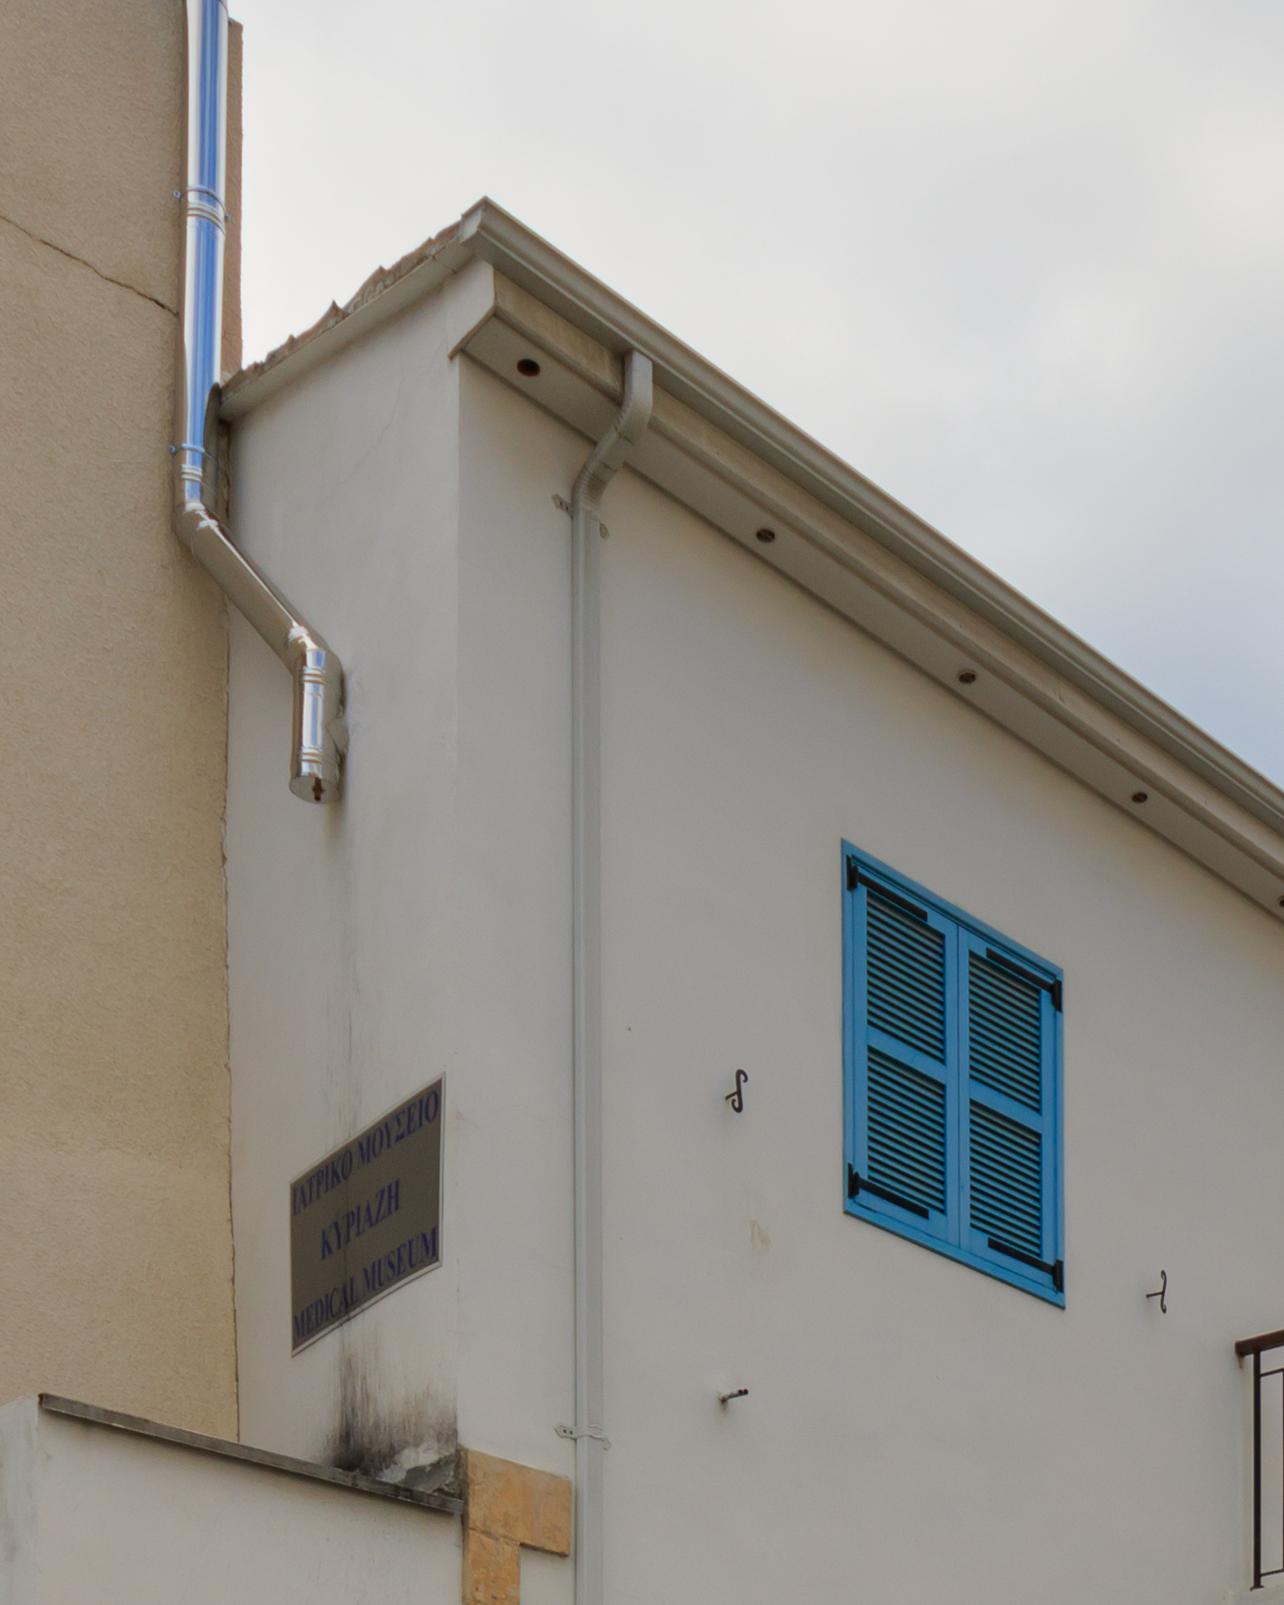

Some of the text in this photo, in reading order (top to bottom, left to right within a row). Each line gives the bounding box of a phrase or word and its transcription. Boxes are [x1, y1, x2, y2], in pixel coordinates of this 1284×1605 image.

[293, 1089, 440, 1216] ΙΑΤΡΙΚΟ ΜΟΥΣΕΙΟ
[320, 1179, 401, 1261] ΚΥΡΙΑΖΗ
[293, 1227, 437, 1339] MEDICAL MUSEUM
